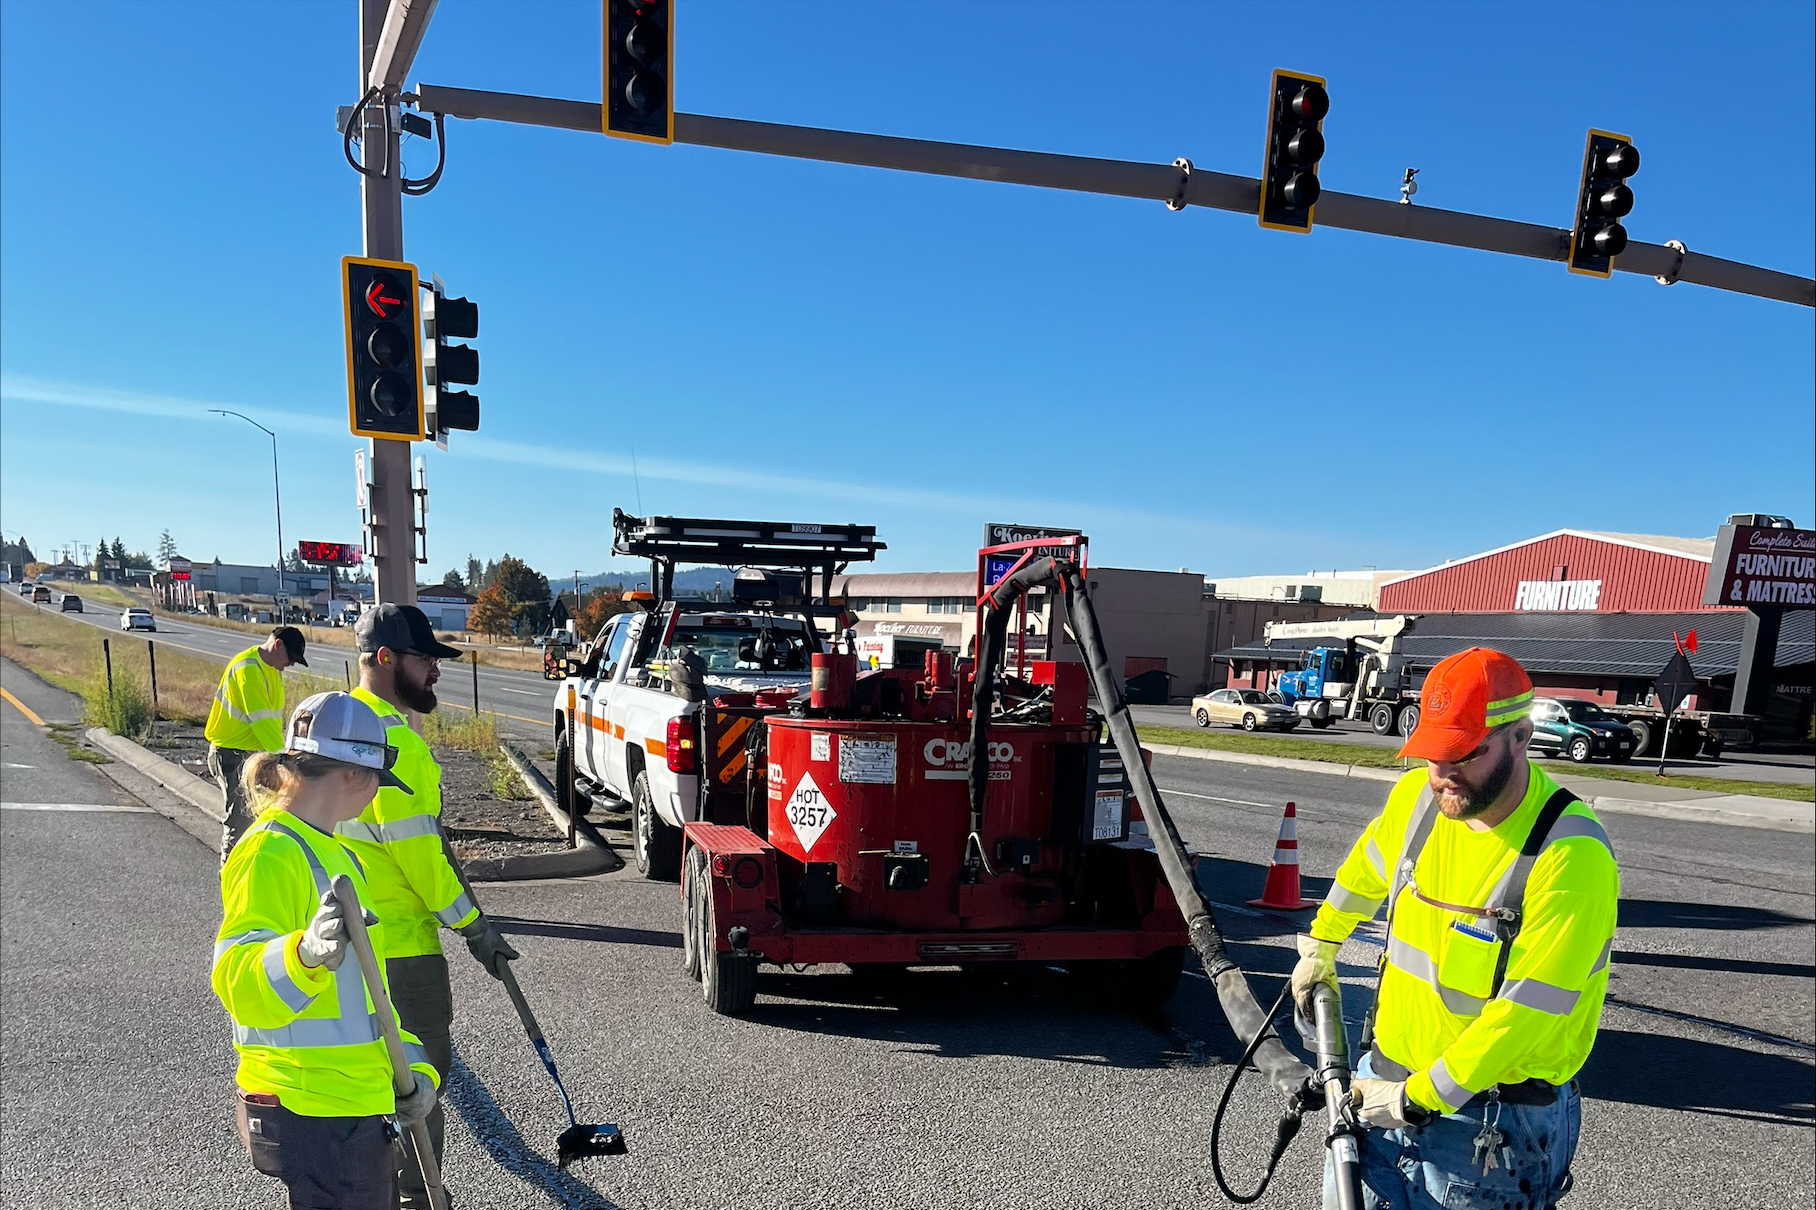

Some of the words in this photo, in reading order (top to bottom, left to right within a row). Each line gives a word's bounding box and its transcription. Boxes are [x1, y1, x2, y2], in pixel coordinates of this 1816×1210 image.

[1750, 531, 1792, 552] Complete
[278, 597, 289, 605] 45
[1515, 580, 1602, 610] FURNITURE
[1730, 578, 1743, 601] &
[1746, 579, 1815, 604] MATTRES
[923, 738, 1014, 766] CRACO
[796, 789, 820, 804] HOT
[790, 805, 827, 828] 3257
